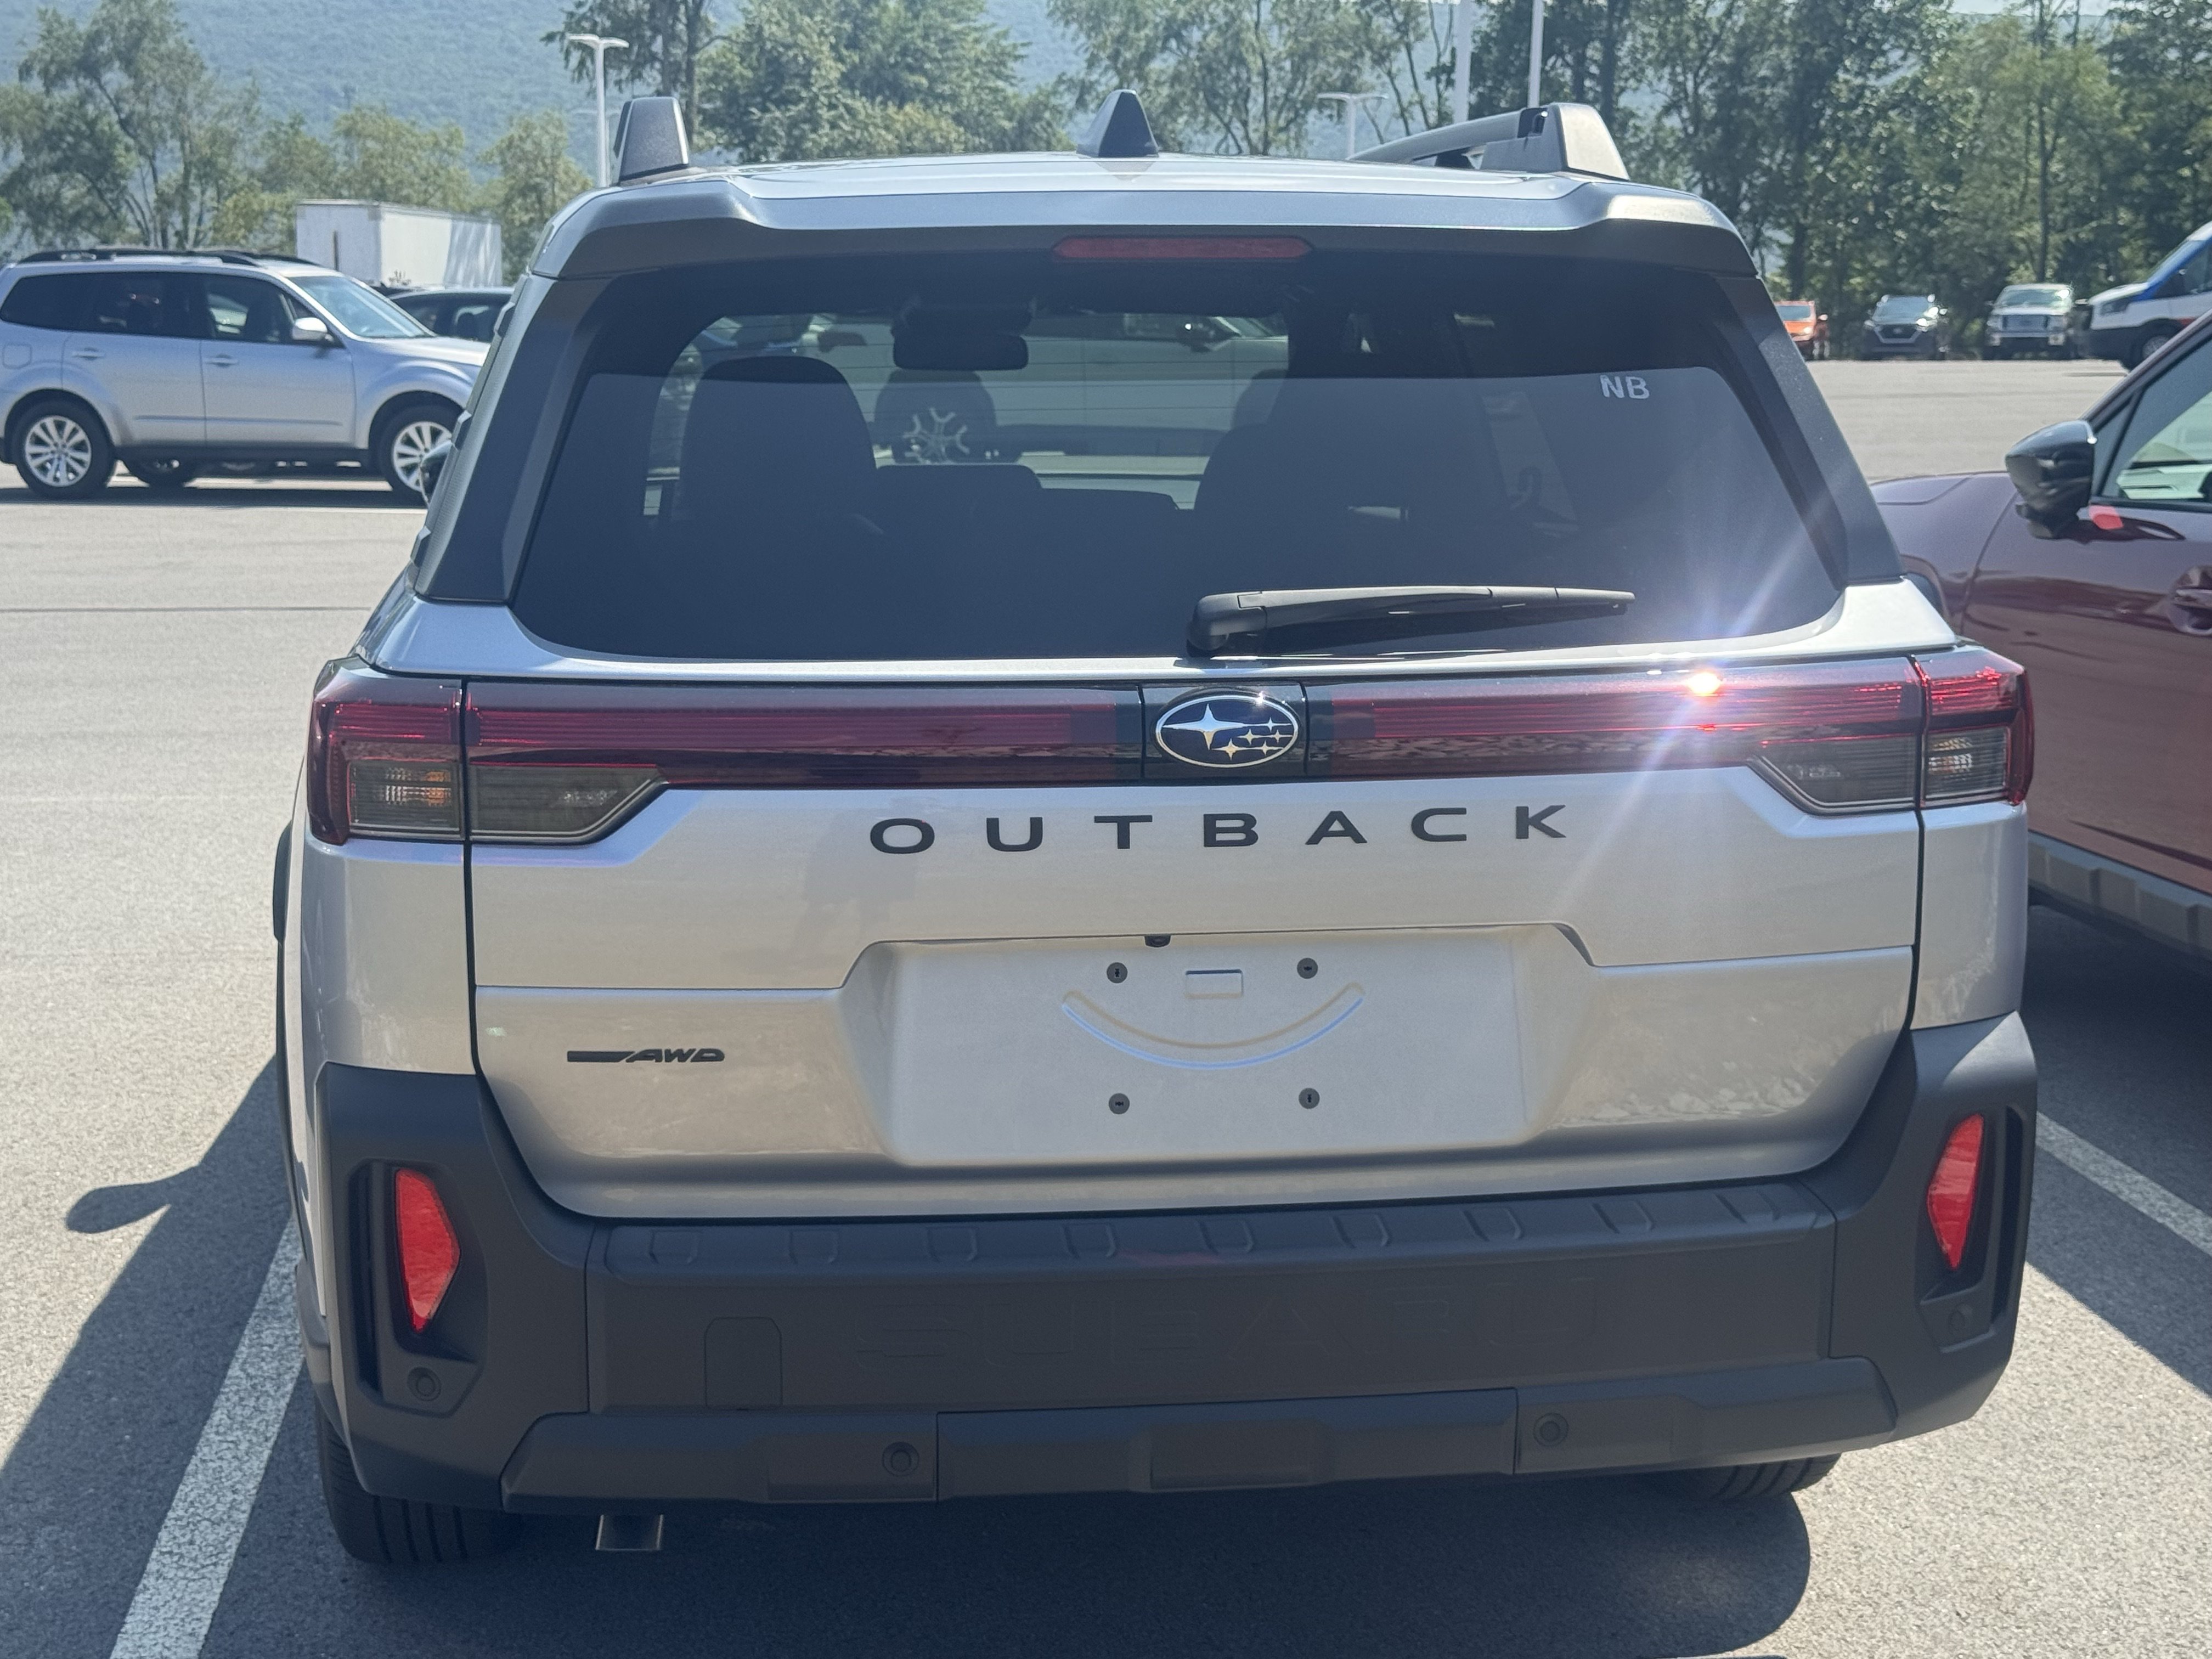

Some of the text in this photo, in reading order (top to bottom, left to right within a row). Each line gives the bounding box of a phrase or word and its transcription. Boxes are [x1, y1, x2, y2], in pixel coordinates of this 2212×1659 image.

[1600, 375, 1650, 399] NB
[870, 804, 1567, 854] OUTBACK
[625, 1048, 725, 1063] AWD
[854, 1276, 1595, 1370] SUBARU
